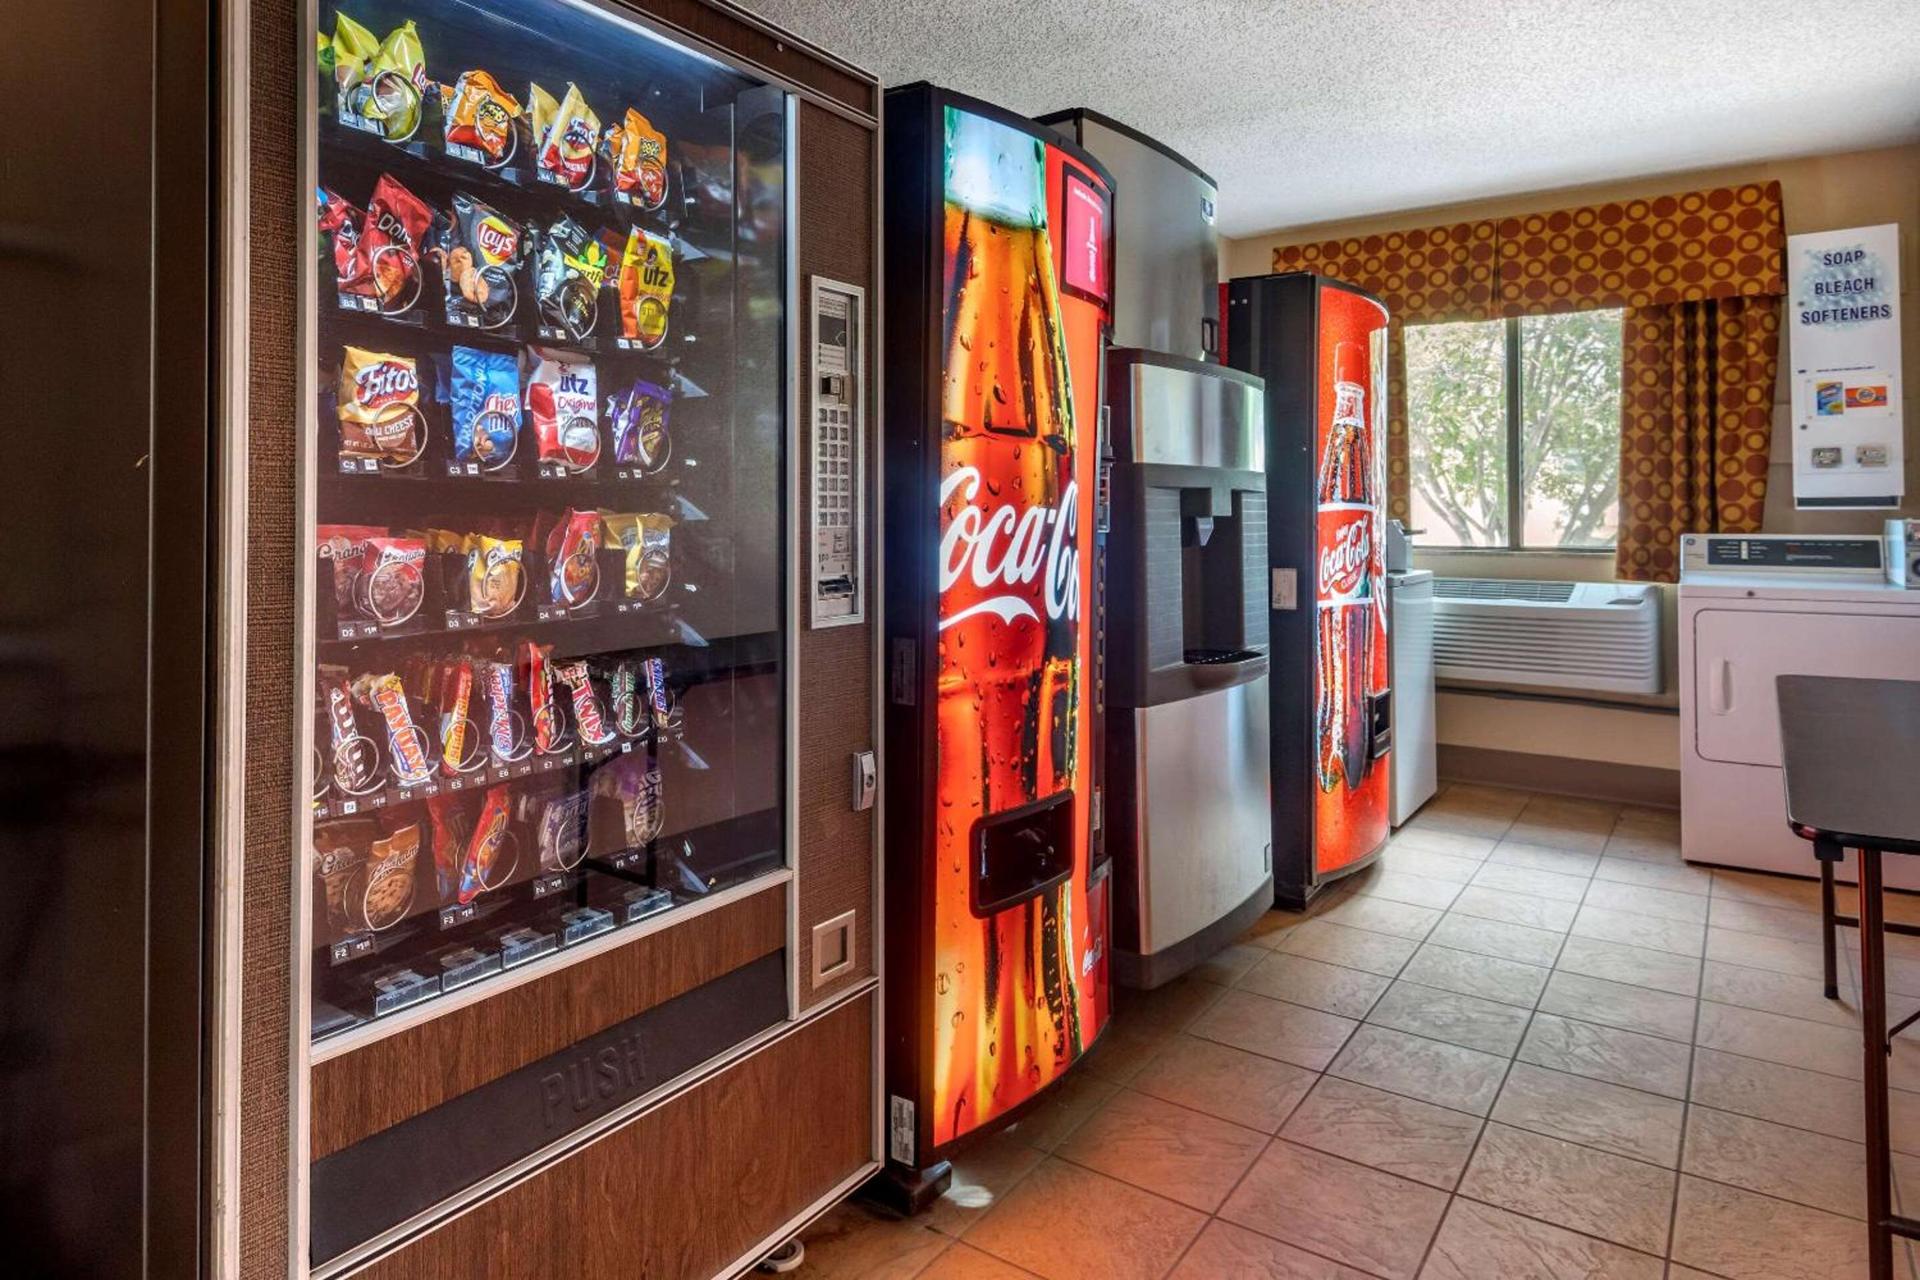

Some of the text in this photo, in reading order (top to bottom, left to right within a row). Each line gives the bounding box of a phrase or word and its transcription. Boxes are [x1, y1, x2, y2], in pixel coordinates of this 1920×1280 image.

[1823, 250, 1864, 267] SOAP
[1814, 277, 1875, 295] BLEACH
[1801, 304, 1890, 325] SOFTENERS
[342, 459, 356, 470] C2
[449, 465, 461, 475] C3
[375, 689, 427, 772] PAYDAY
[540, 1033, 647, 1129] PUSH
